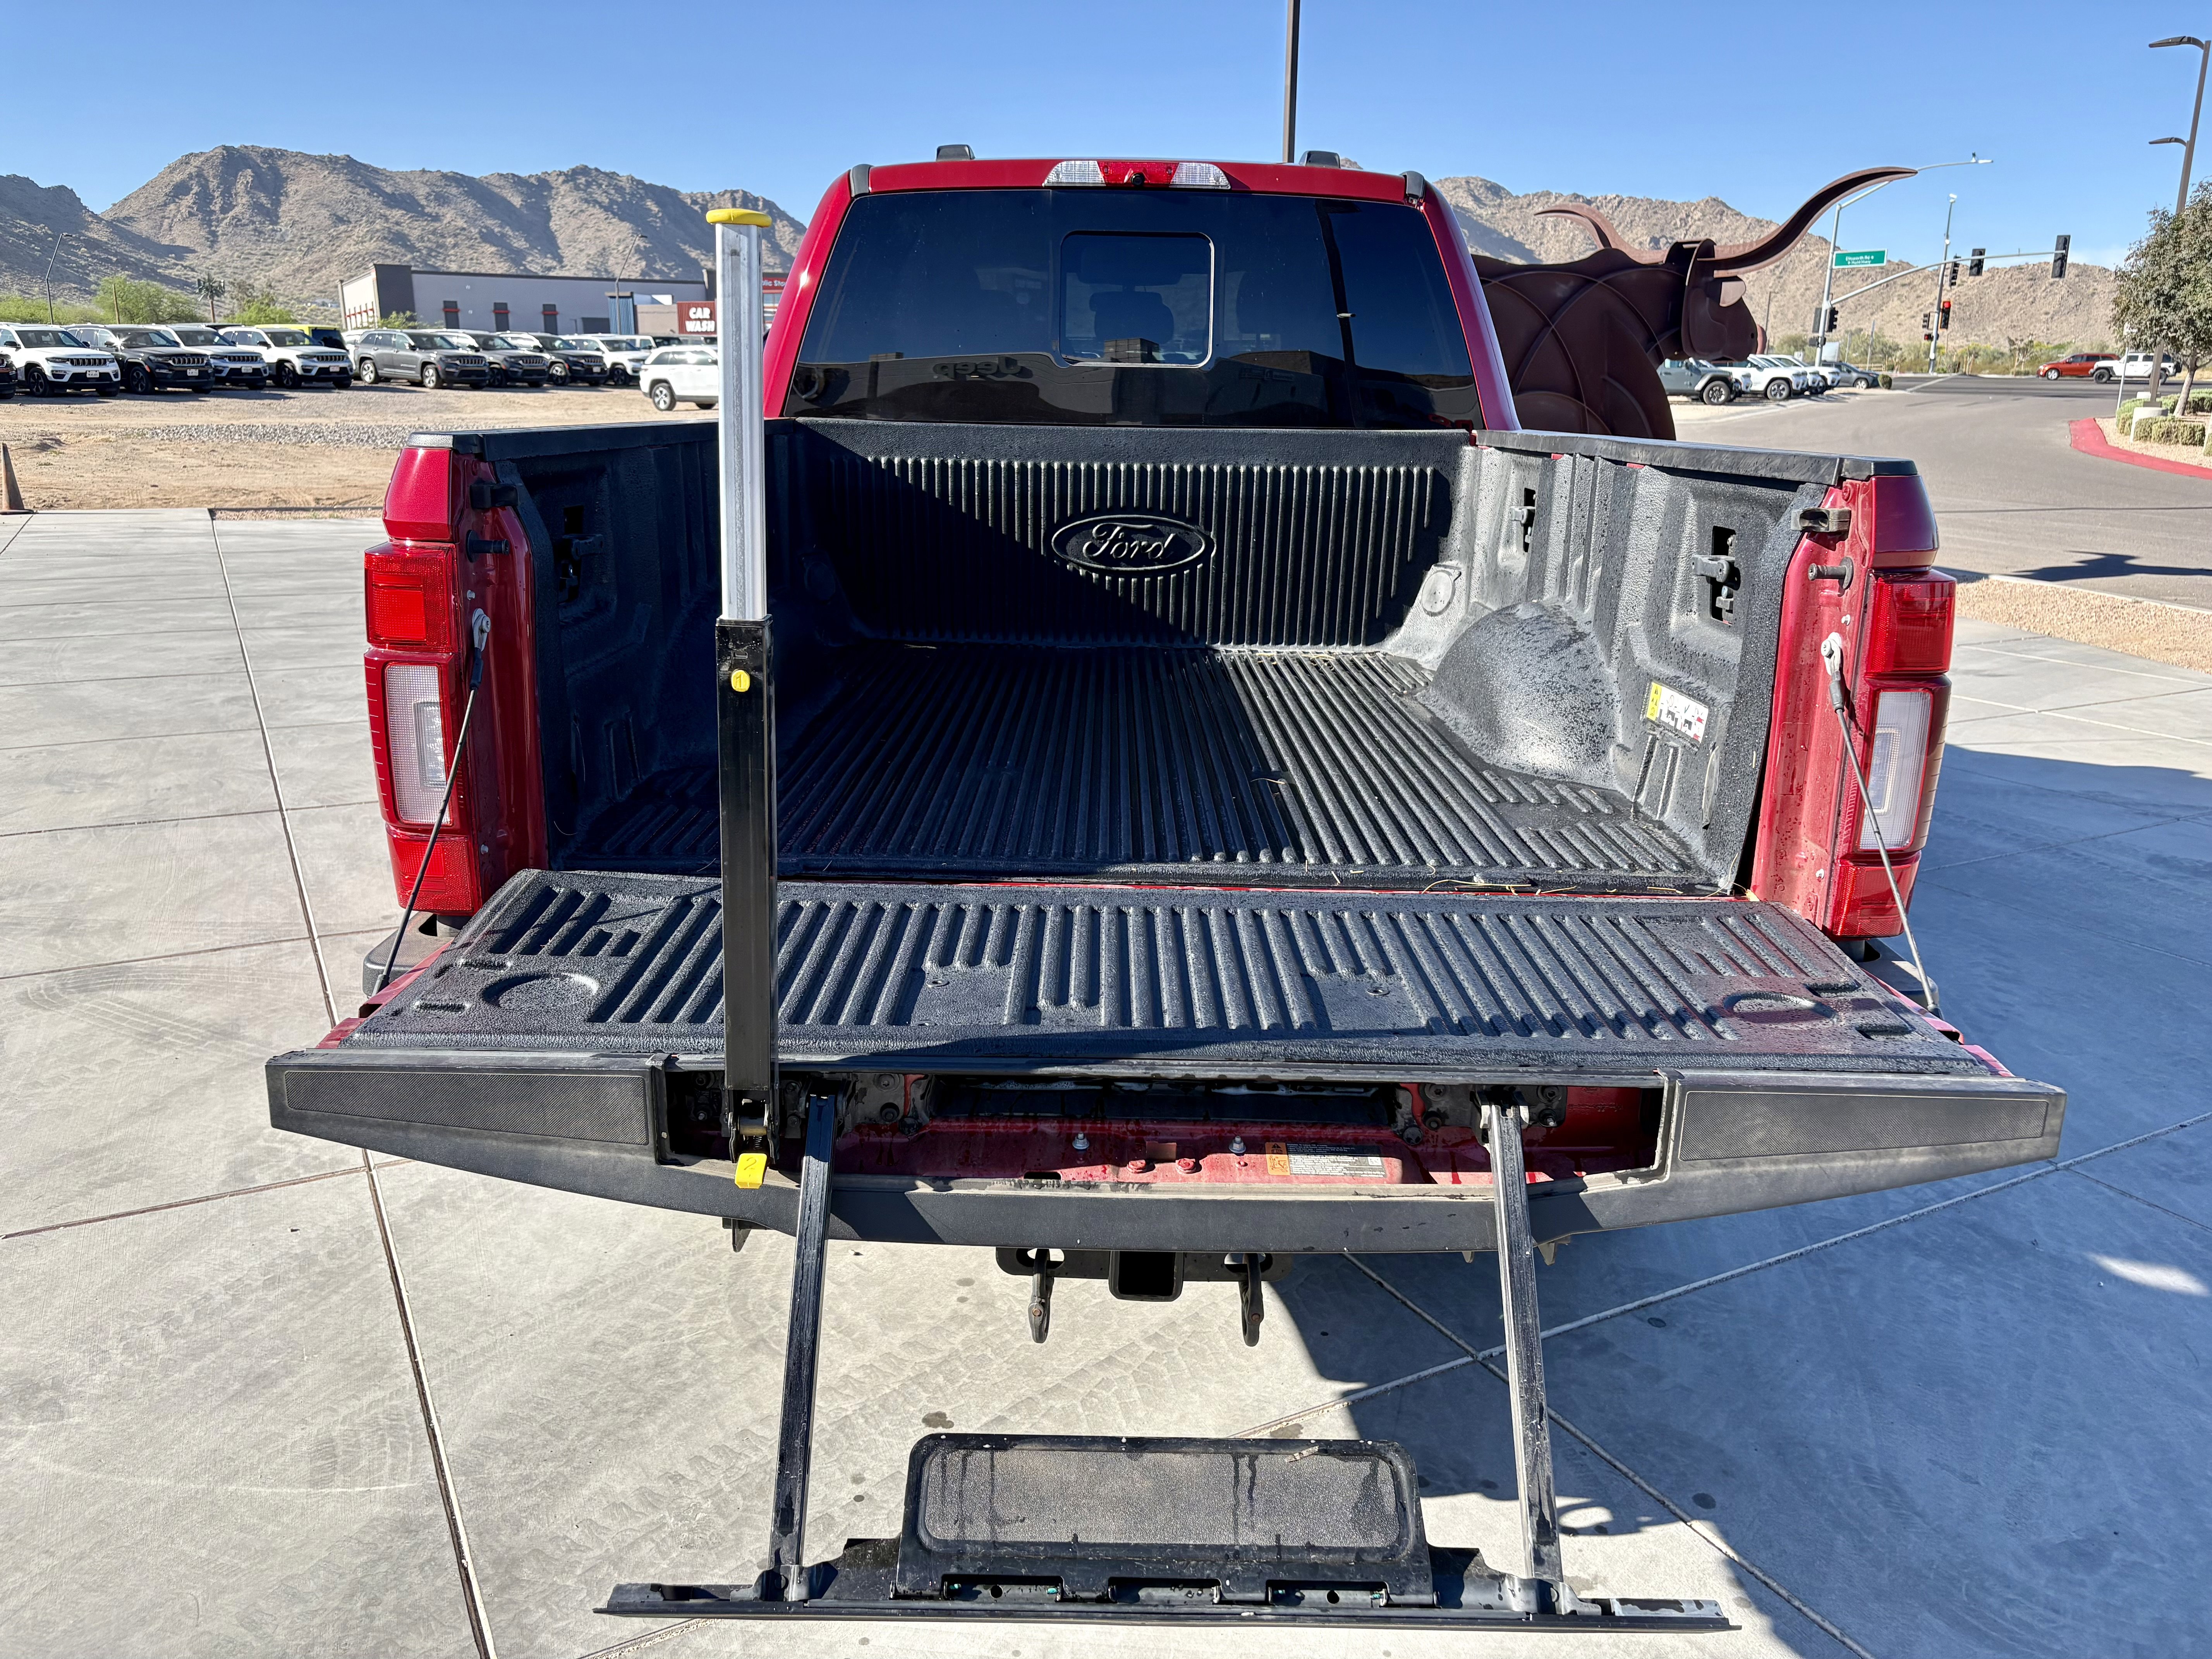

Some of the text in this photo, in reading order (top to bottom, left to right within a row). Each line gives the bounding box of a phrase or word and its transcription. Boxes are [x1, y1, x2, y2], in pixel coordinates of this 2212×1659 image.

[689, 307, 710, 319] CAR
[685, 320, 715, 332] WASH
[1083, 522, 1176, 559] Ford
[744, 1157, 757, 1170] 2
